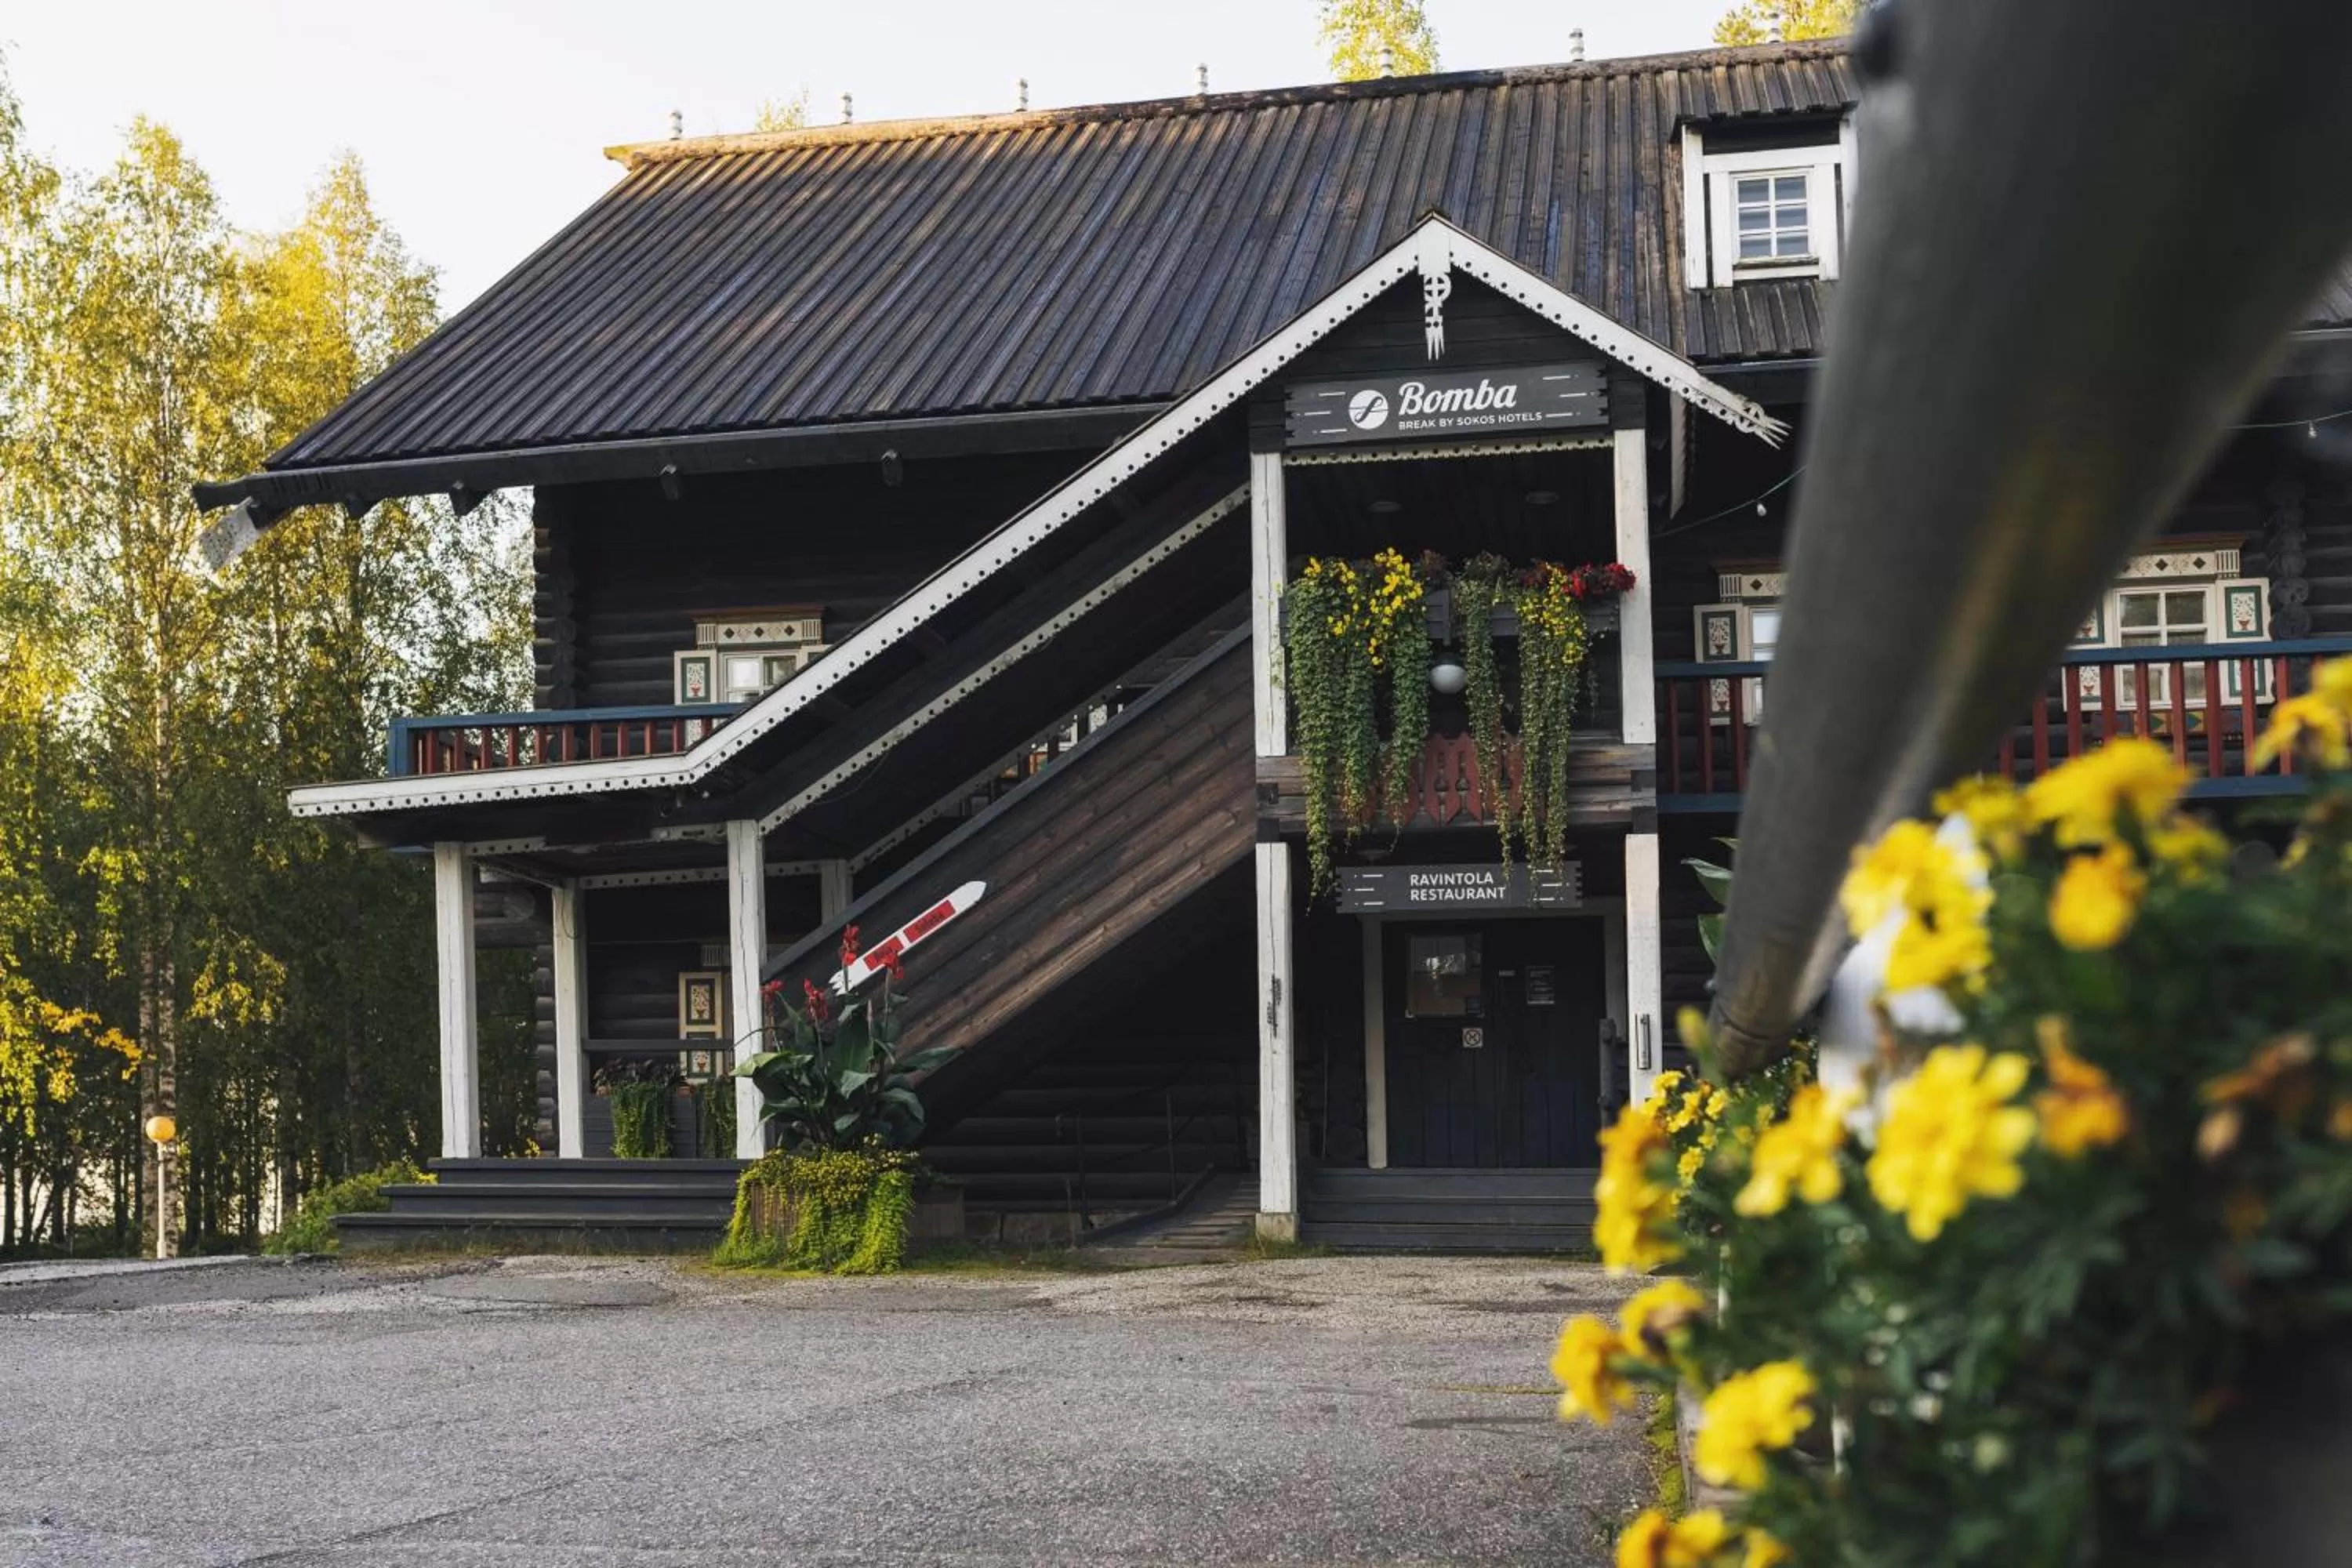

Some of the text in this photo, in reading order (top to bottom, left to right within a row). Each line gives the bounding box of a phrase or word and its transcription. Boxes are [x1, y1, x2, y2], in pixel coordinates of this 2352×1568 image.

[1399, 379, 1517, 416] Bomba
[1399, 412, 1542, 430] BREAK BY SOKOS HOTELS
[1411, 872, 1494, 886] RAVINTOLA
[1411, 887, 1505, 901] RESTAURANT
